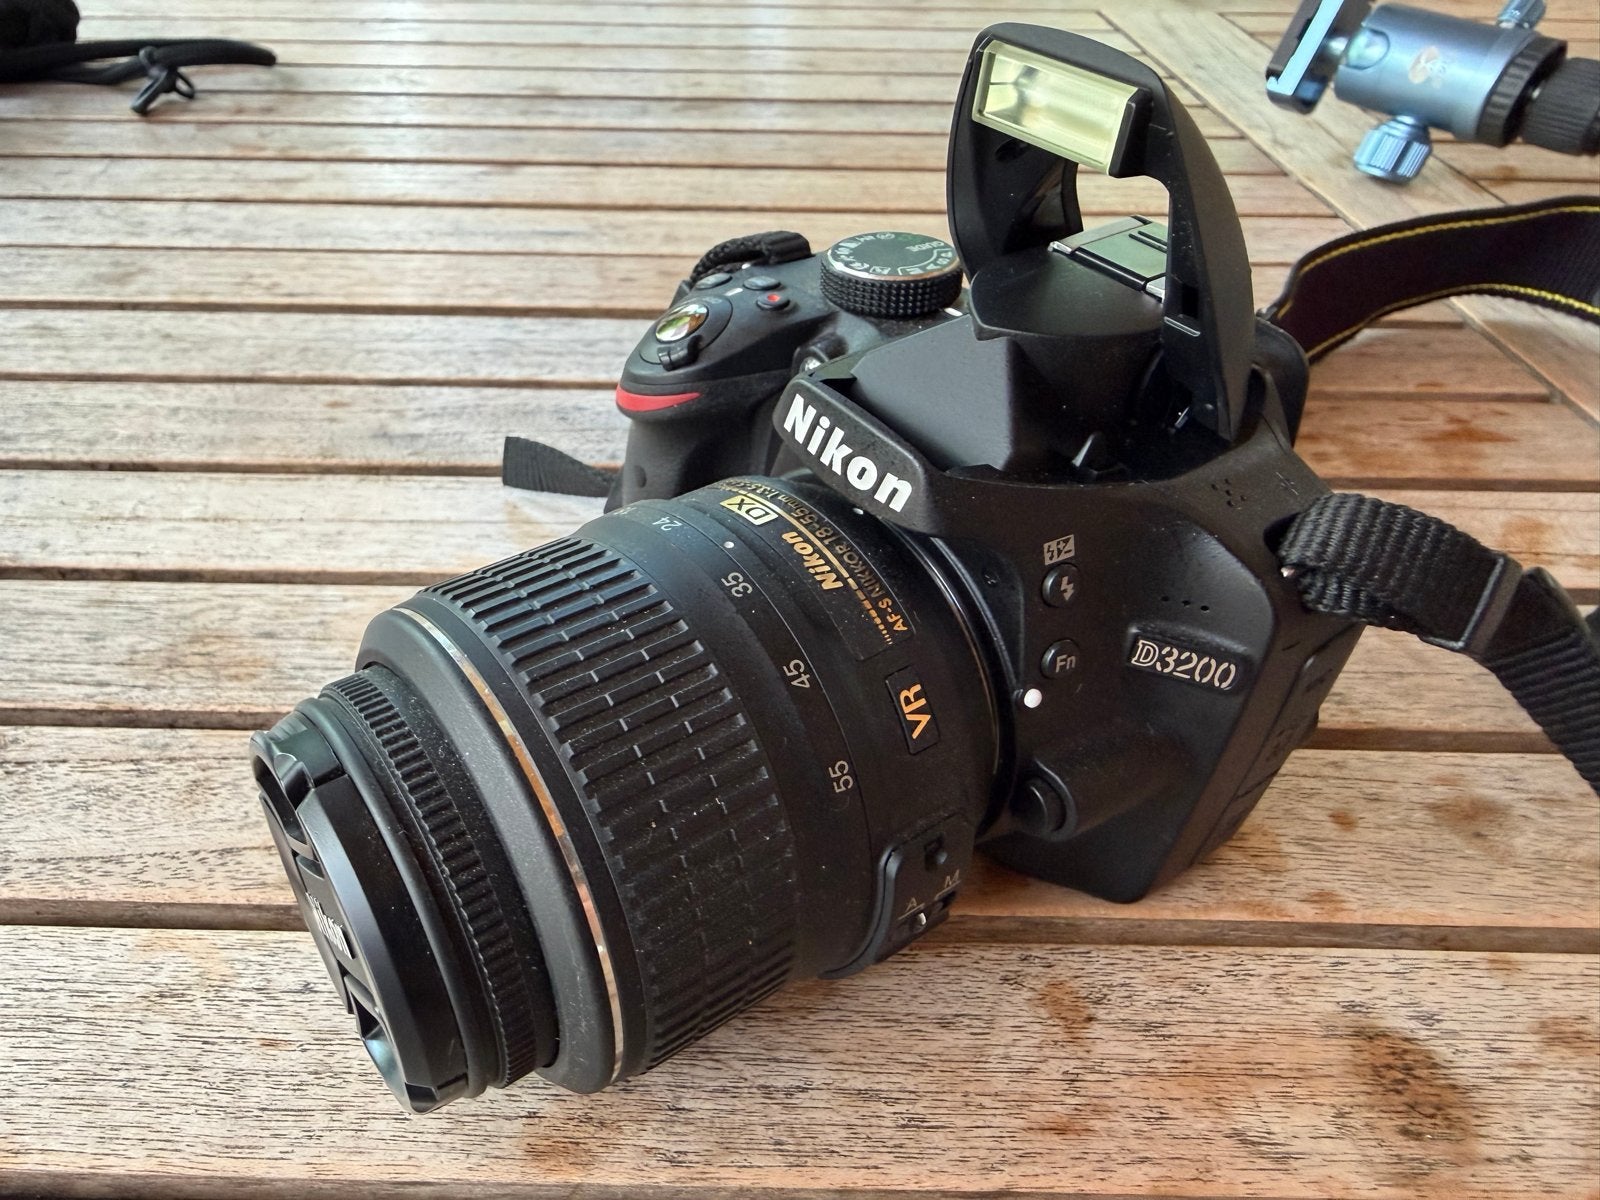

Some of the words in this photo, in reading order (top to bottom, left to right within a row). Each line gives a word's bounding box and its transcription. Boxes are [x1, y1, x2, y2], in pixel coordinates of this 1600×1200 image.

[783, 393, 912, 512] Nikon
[652, 516, 682, 531] 24
[724, 496, 774, 522] DX
[777, 494, 840, 545] 18-55mm
[782, 531, 844, 590] Nikon
[835, 544, 885, 598] NIKKOR
[721, 571, 753, 598] 35
[878, 598, 908, 631] AF-S
[782, 659, 811, 689] 45
[1055, 655, 1076, 673] Fn
[1131, 639, 1236, 690] D3200
[900, 684, 931, 739] VR
[828, 760, 853, 793] 55
